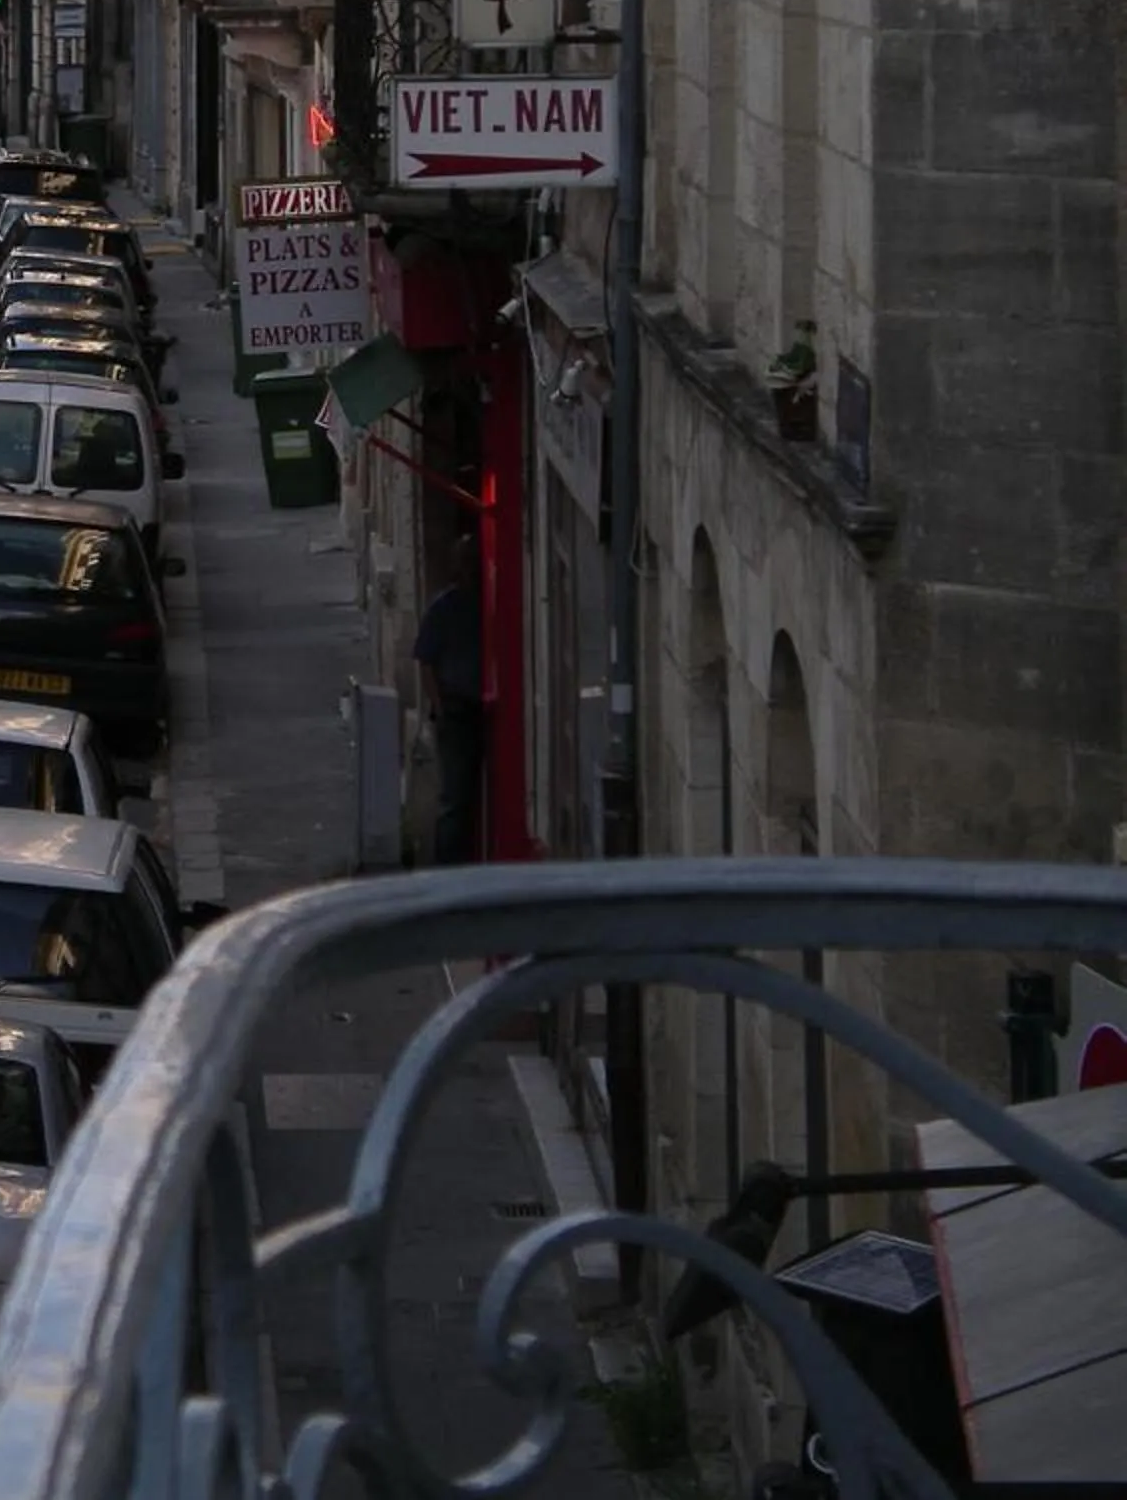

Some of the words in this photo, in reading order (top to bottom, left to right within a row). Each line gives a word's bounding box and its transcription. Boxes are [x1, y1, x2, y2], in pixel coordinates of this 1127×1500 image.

[246, 185, 355, 218] PIZZERIA
[248, 234, 332, 263] PLATS
[339, 231, 360, 258] &
[249, 265, 360, 296] PIZZAS
[298, 301, 313, 319] A
[250, 321, 365, 348] EMPORTER
